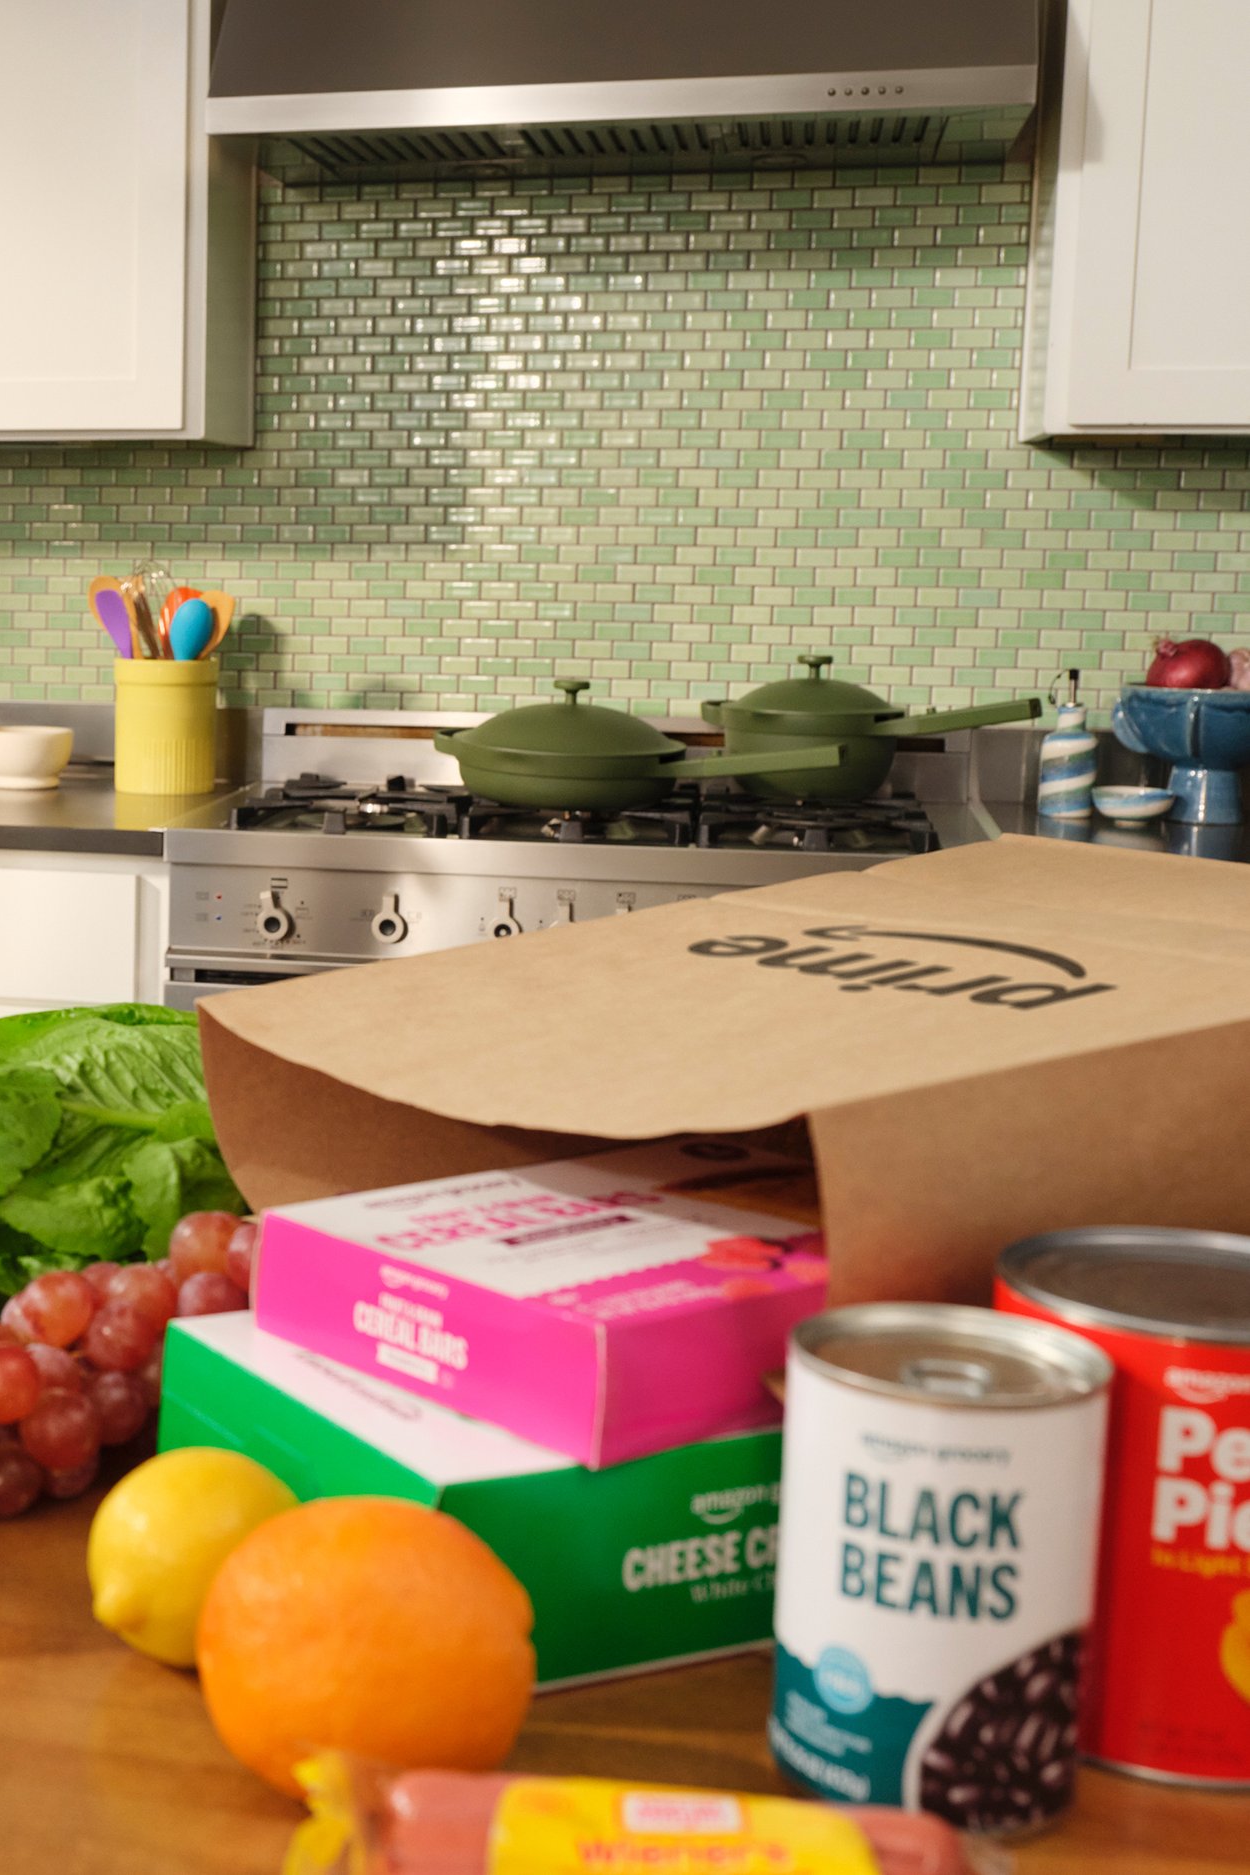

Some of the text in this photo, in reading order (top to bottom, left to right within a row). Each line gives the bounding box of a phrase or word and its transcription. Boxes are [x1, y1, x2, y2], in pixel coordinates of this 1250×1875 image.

[687, 935, 1119, 1009] prime
[353, 1300, 415, 1351] CEREAL
[416, 1322, 469, 1371] BARS
[1158, 1405, 1250, 1483] Pe
[842, 1471, 1026, 1550] BLACK
[622, 1530, 742, 1592] CHEESE
[839, 1542, 1021, 1623] BEANS
